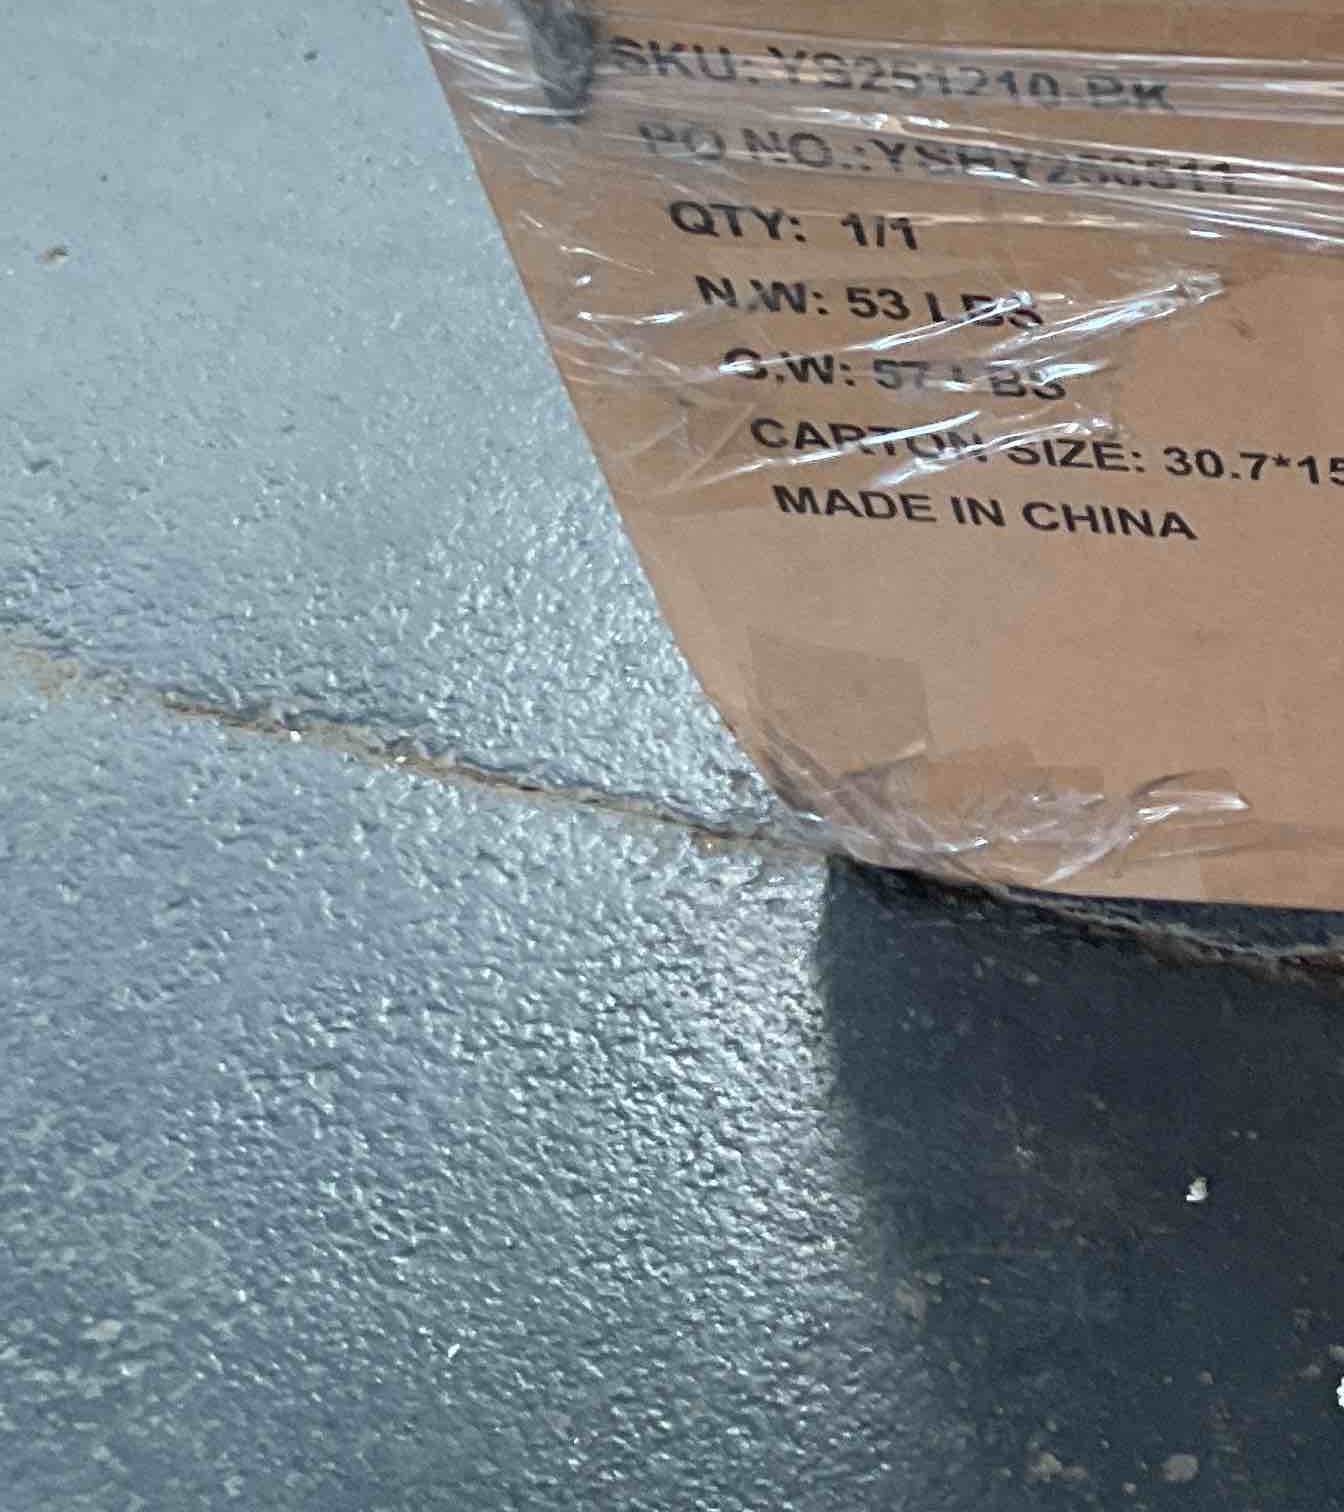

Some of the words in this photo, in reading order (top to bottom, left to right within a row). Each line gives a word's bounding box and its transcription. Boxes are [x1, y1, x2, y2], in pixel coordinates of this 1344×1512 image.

[670, 200, 806, 243] QTY:
[841, 214, 920, 250] 1/1
[695, 274, 829, 315] N.W:
[845, 286, 911, 321] 53
[872, 358, 928, 389] 57
[750, 417, 988, 462] CARTON
[1008, 433, 1144, 474] SIZE:
[771, 484, 938, 523] MADE
[950, 494, 1007, 528] IN
[1021, 500, 1199, 541] CHINA
